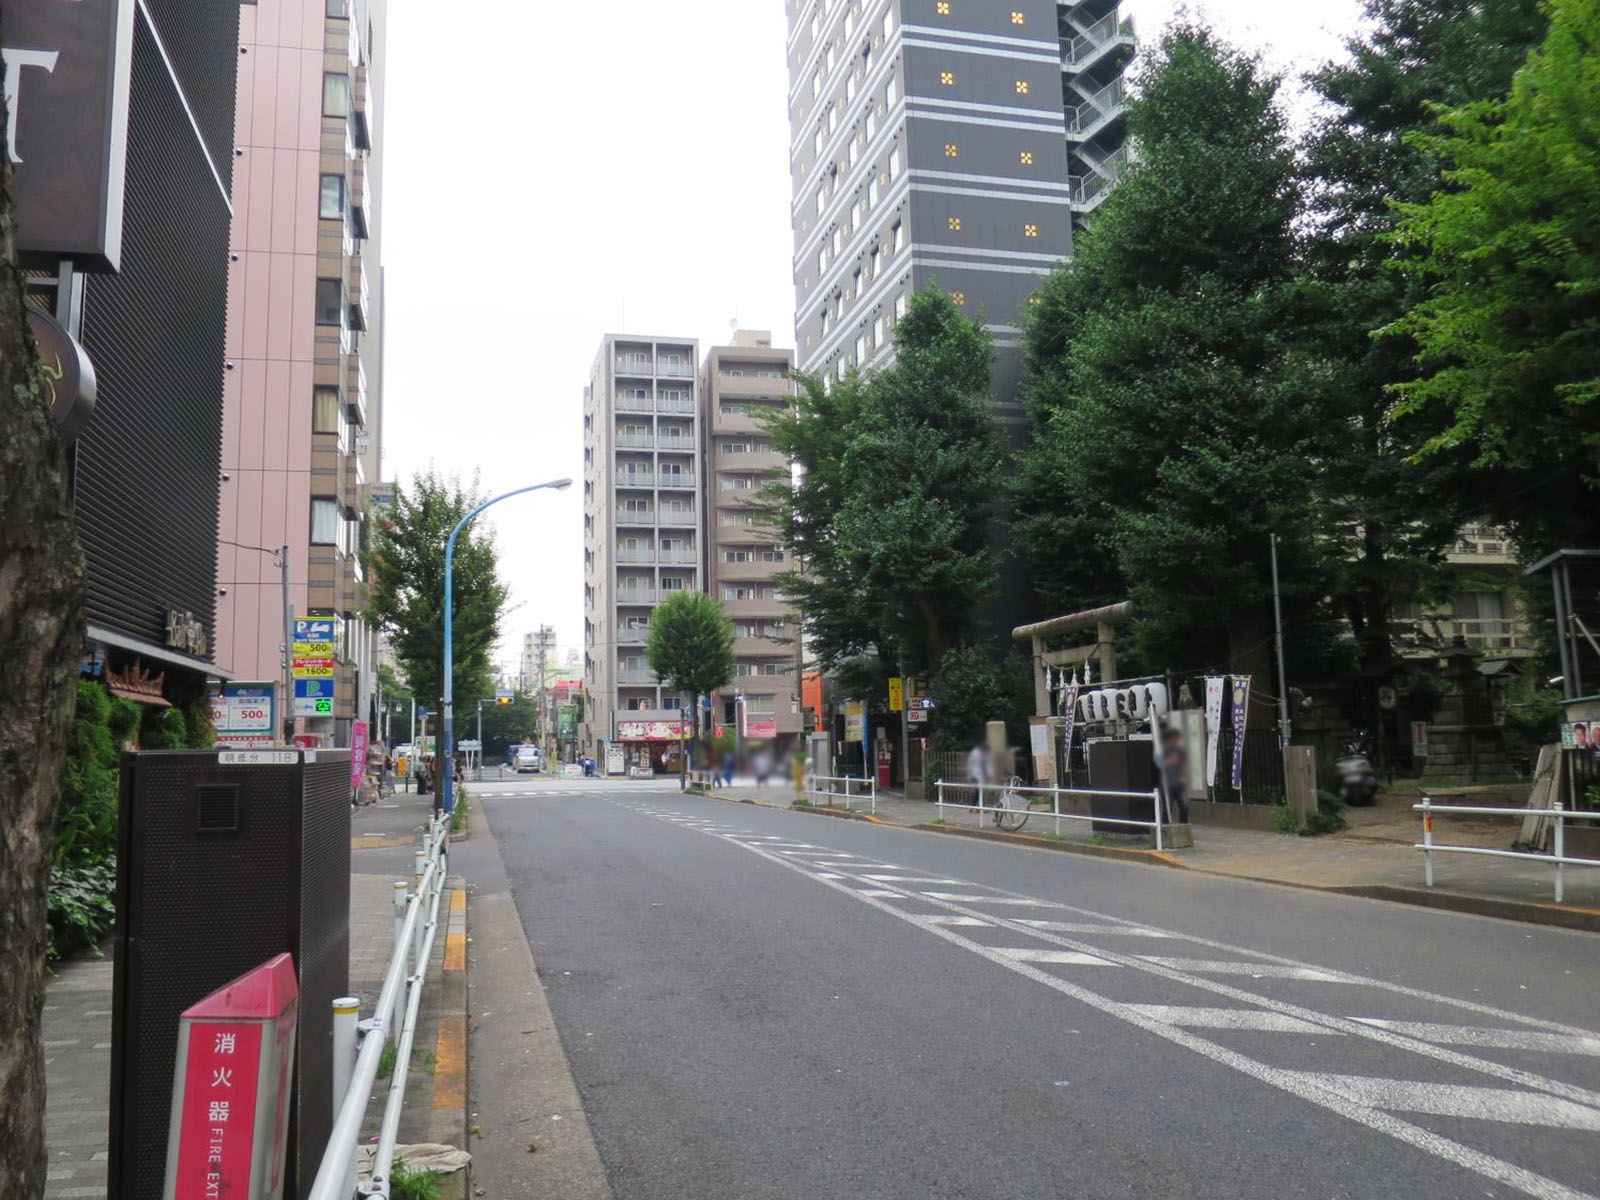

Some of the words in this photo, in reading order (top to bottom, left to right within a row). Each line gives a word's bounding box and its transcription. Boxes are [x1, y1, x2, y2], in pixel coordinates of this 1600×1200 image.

[272, 753, 292, 762] 118
[208, 1033, 236, 1122] 消火器
[208, 1128, 224, 1163] FIRE
